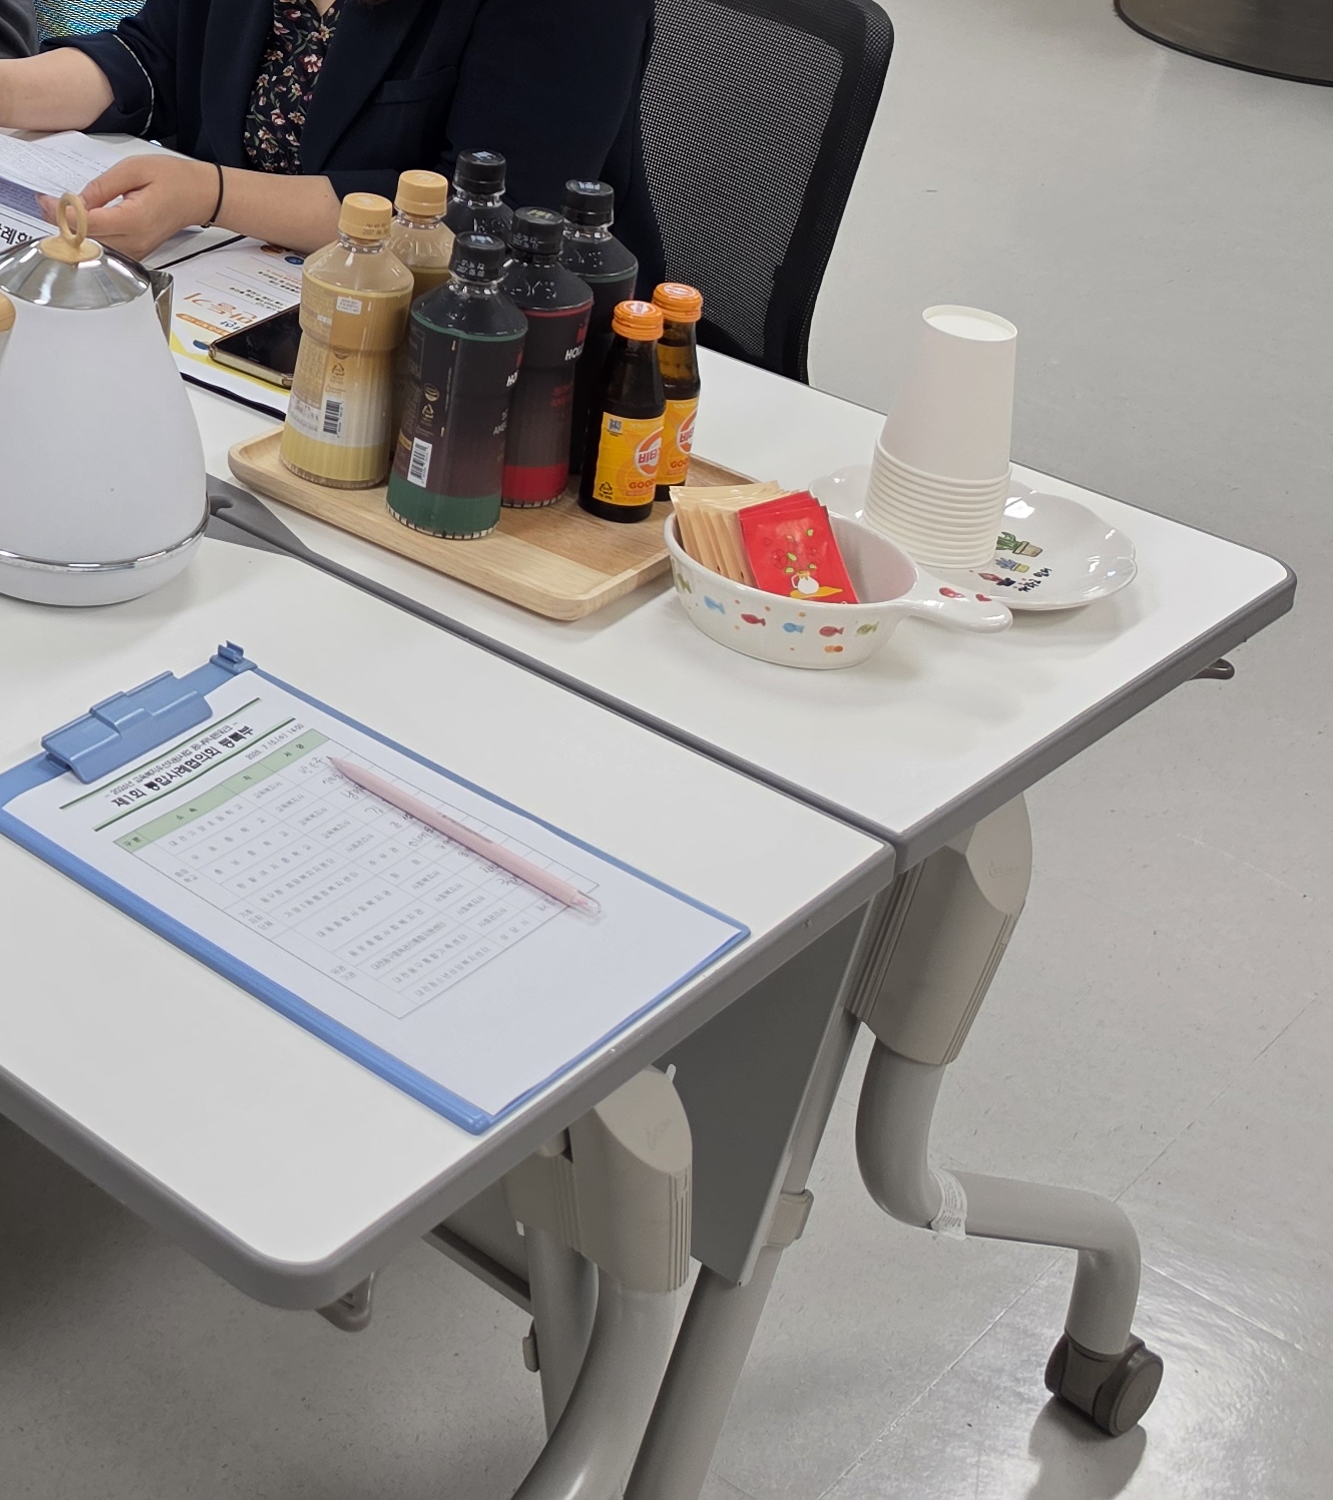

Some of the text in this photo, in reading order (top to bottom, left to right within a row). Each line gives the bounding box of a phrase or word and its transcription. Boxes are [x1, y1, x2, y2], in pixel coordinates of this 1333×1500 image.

[110, 724, 259, 809] 제1회 통합사례협의회 등록부
